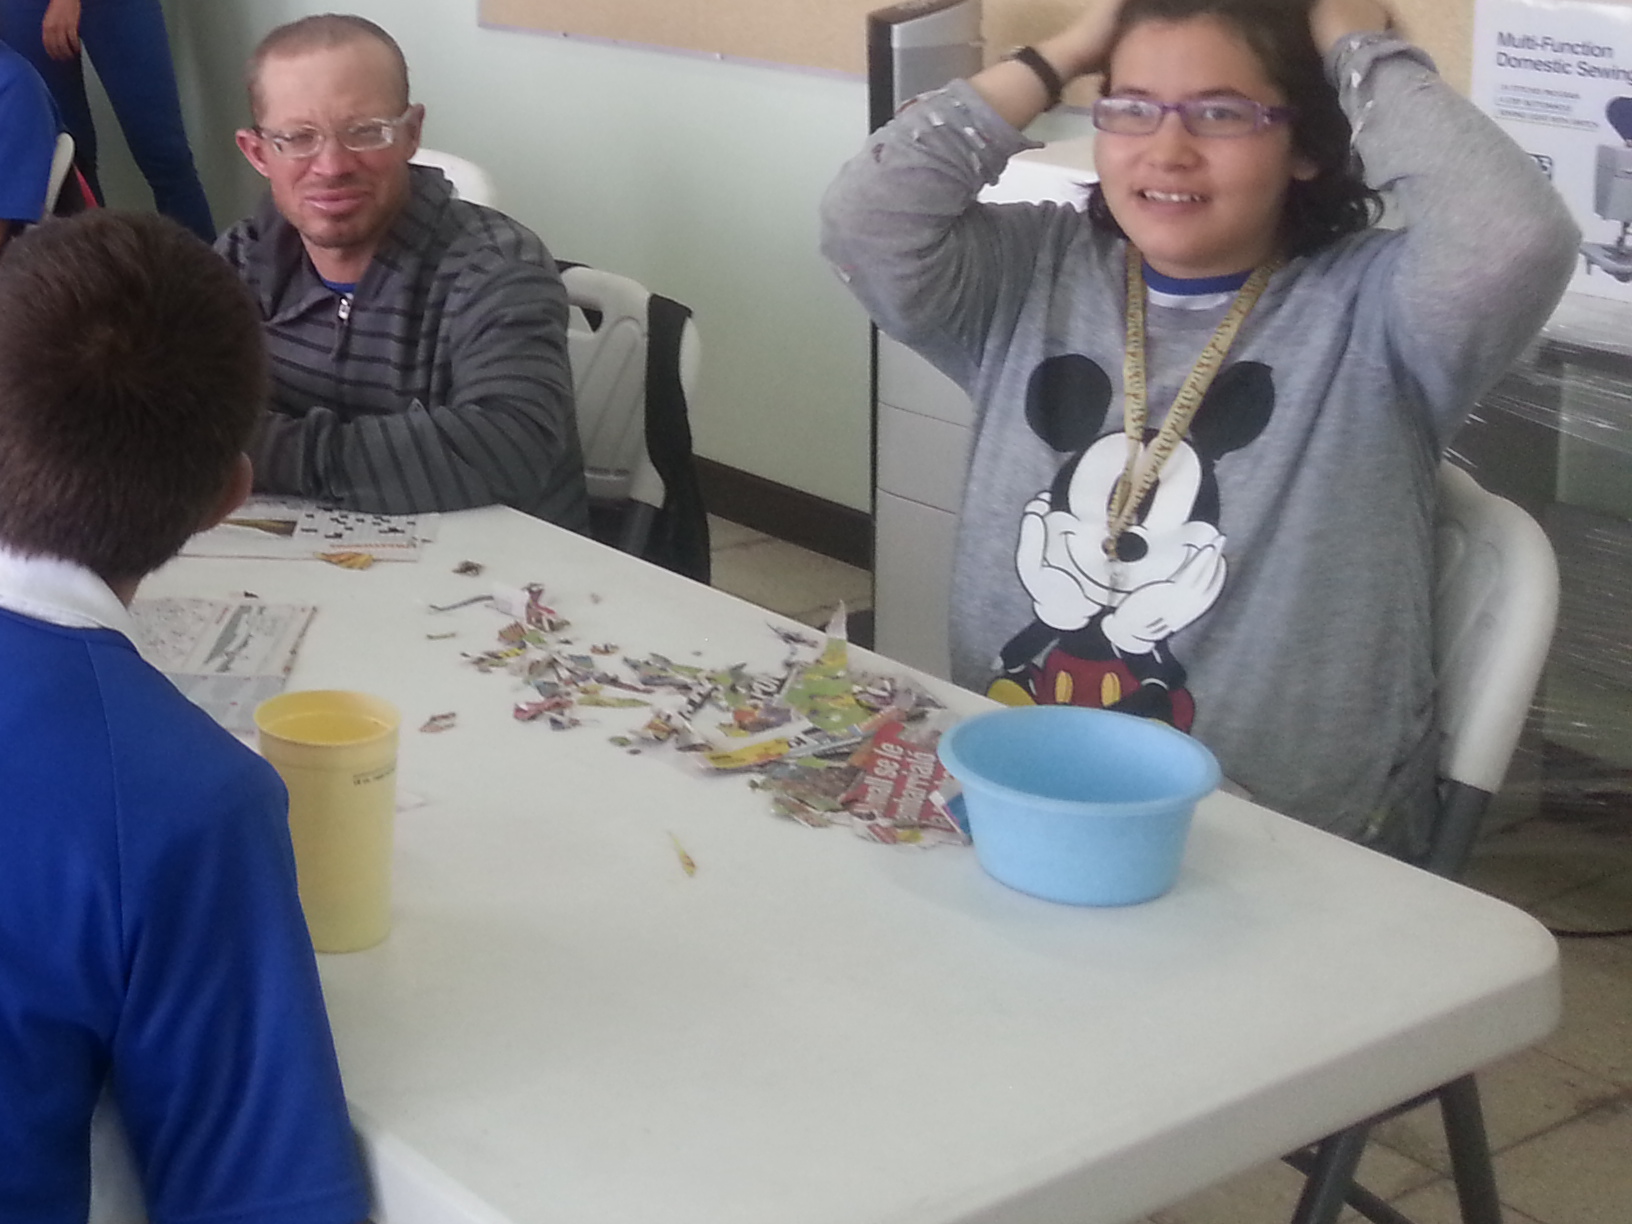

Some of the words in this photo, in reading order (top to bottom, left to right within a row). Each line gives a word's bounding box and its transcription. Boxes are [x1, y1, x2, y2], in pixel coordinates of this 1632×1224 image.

[1497, 31, 1613, 59] Multi-Function
[1495, 51, 1572, 75] Domestic
[873, 742, 904, 761] le
[873, 758, 900, 779] se
